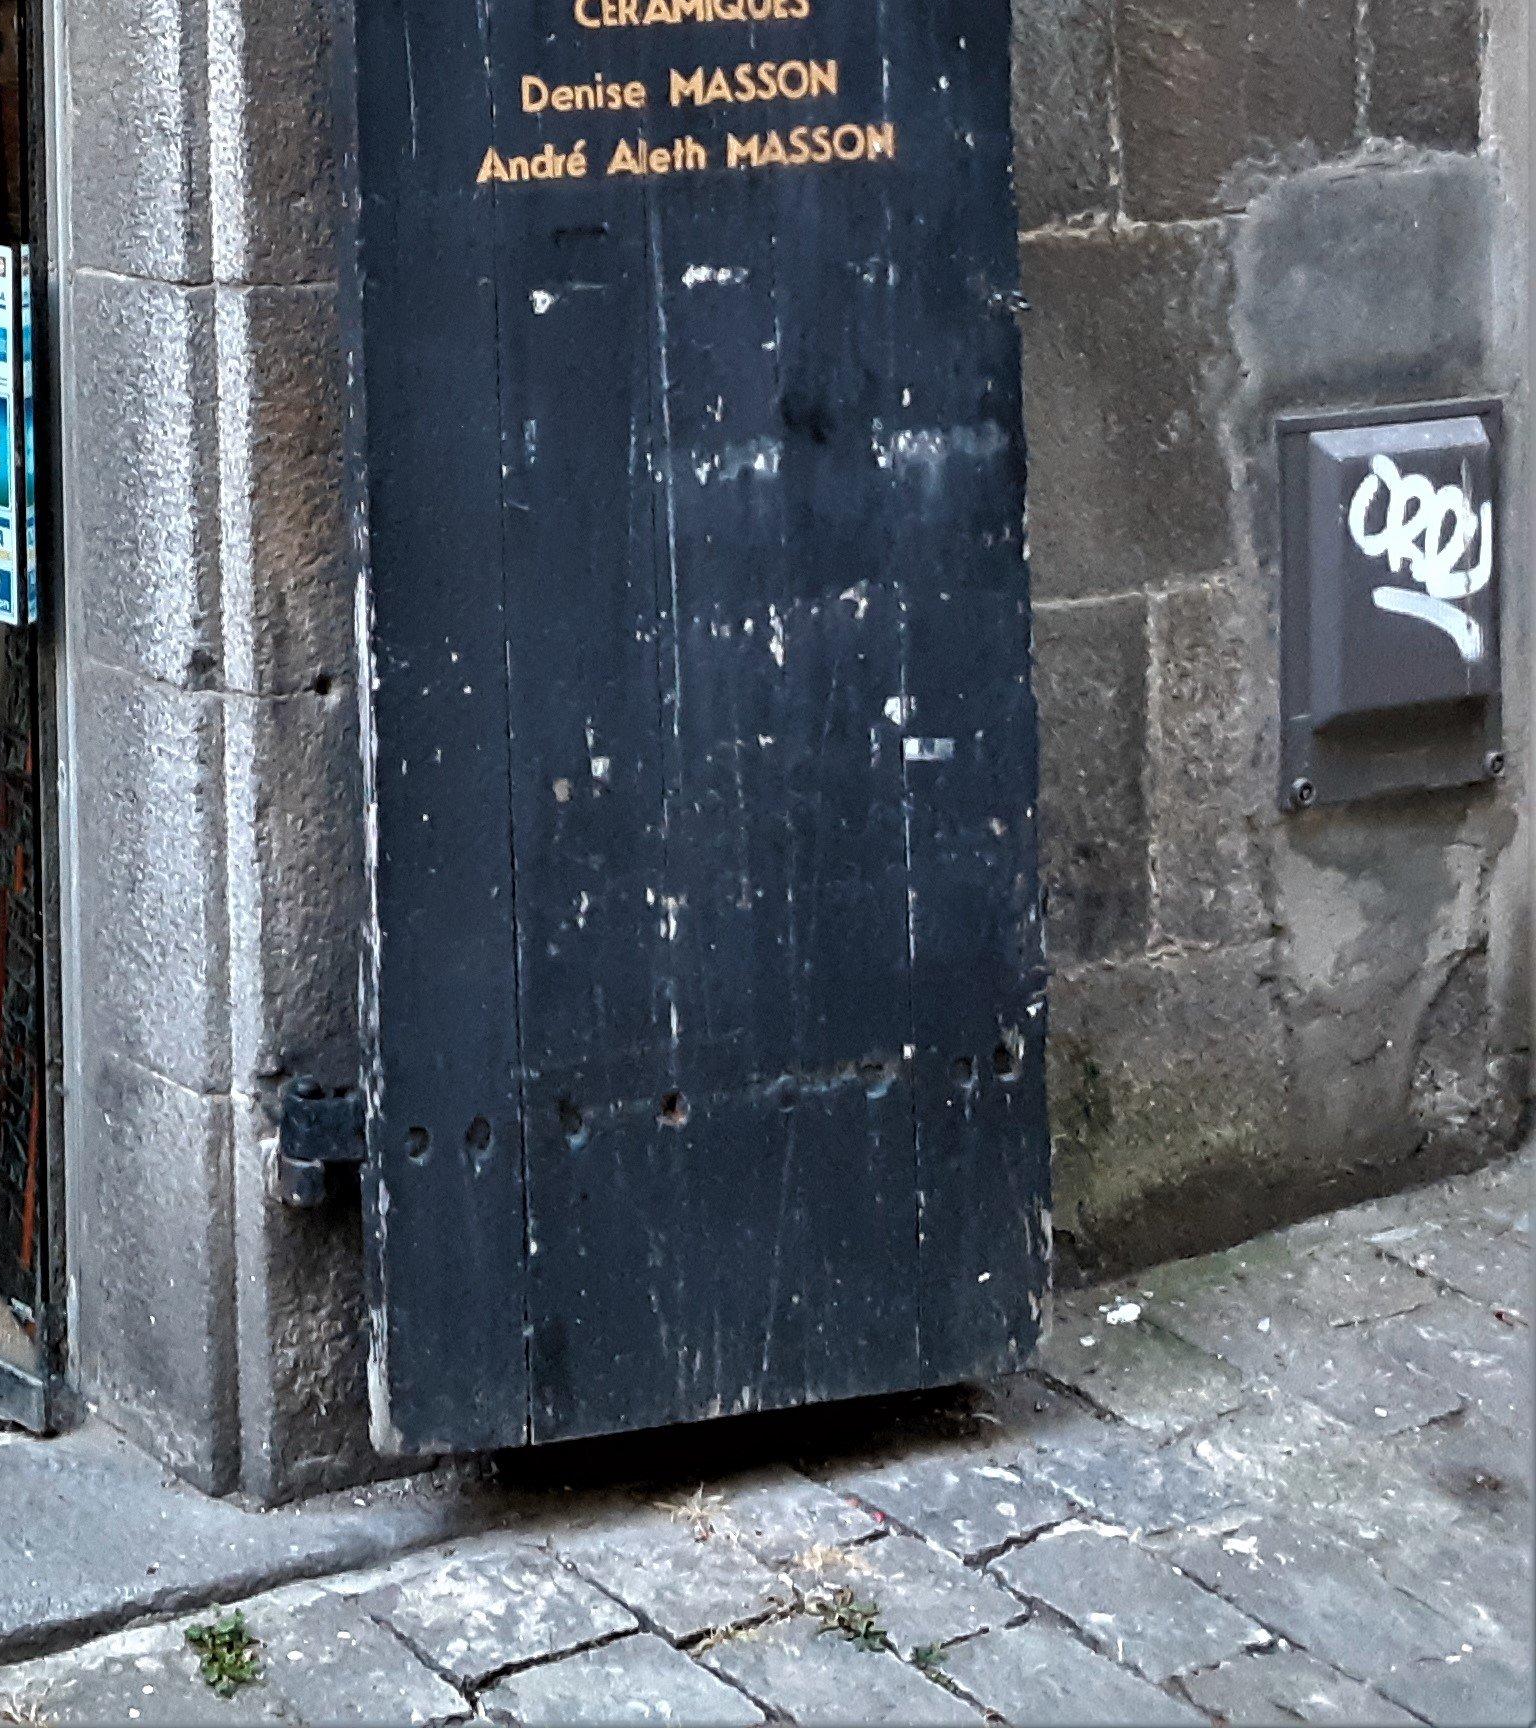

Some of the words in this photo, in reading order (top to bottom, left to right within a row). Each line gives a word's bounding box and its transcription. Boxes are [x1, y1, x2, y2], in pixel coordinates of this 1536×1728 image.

[521, 73, 647, 113] Denise
[670, 59, 839, 108] MASSON
[476, 138, 588, 184] André
[607, 133, 708, 177] Aleth
[727, 122, 896, 169] MASSON
